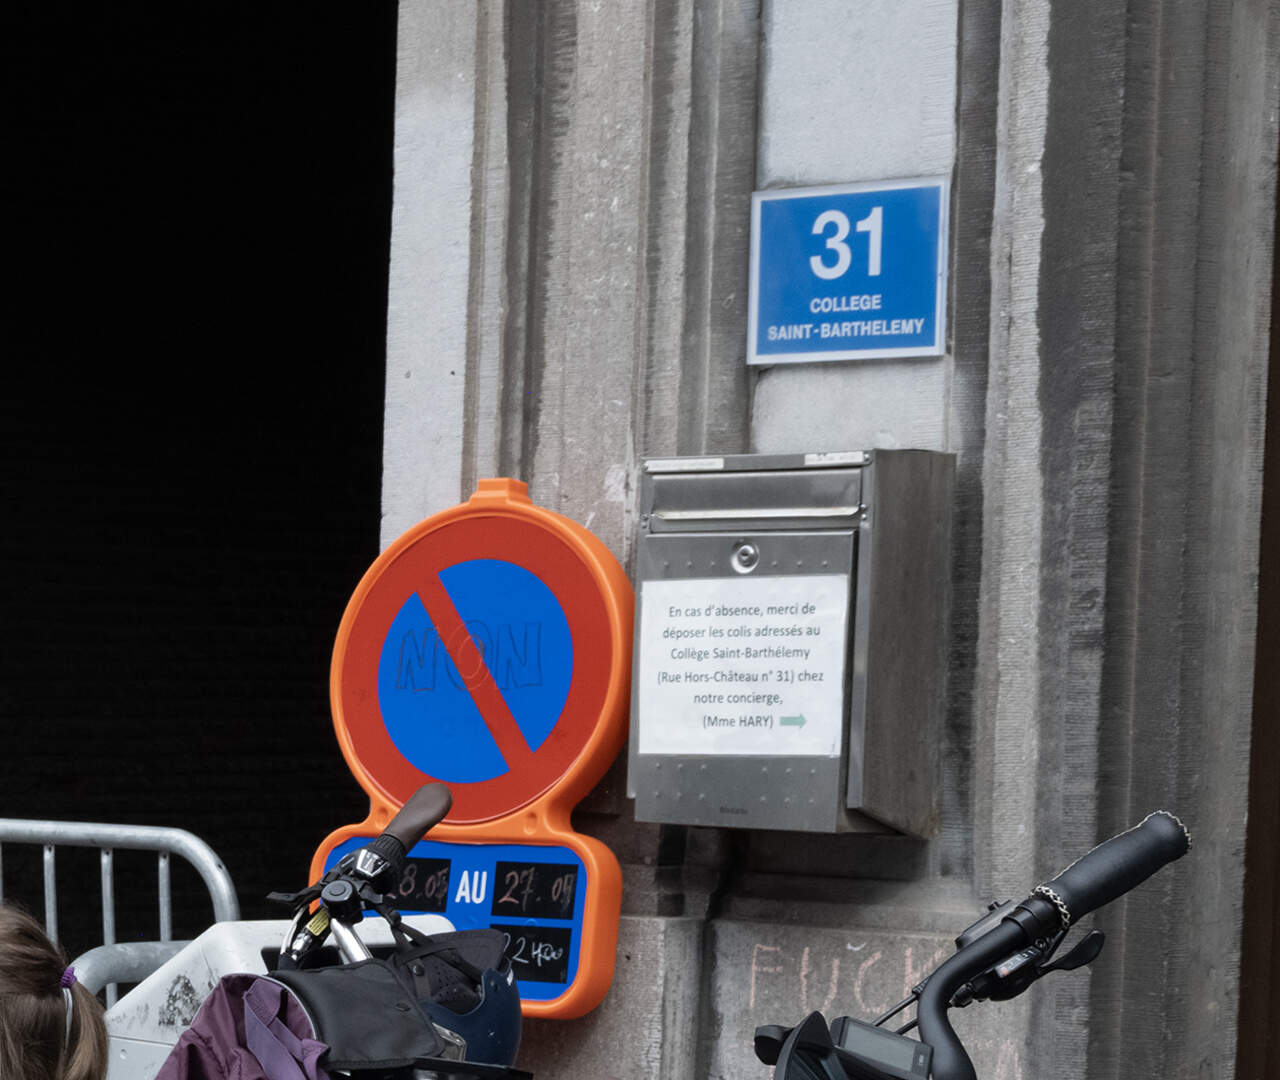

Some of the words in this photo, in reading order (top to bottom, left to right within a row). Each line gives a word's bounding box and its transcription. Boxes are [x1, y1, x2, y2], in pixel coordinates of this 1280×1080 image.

[809, 206, 883, 280] 31
[809, 294, 882, 314] COLLEGE
[767, 318, 925, 341] SAINT-BARTHELEMY
[668, 606, 682, 617] En
[684, 607, 702, 617] cas
[766, 604, 798, 616] merci
[801, 602, 816, 614] de
[662, 627, 706, 641] déposer
[708, 626, 724, 638] les
[727, 626, 752, 637] colis
[754, 625, 803, 638] adressés
[806, 626, 821, 636] au
[395, 619, 543, 694] NON
[670, 648, 710, 662] Collège
[712, 646, 810, 660] Saint-Barthélemy
[657, 671, 681, 685] (Rue
[684, 670, 758, 683] Hors-Château
[776, 670, 795, 684] 31)
[797, 669, 824, 682] chez
[693, 693, 724, 704] notre
[726, 692, 784, 706] concierge,
[702, 716, 735, 729] (Mme
[738, 716, 774, 729] HARY)
[455, 870, 488, 904] AU
[749, 943, 948, 1021] FUCK
